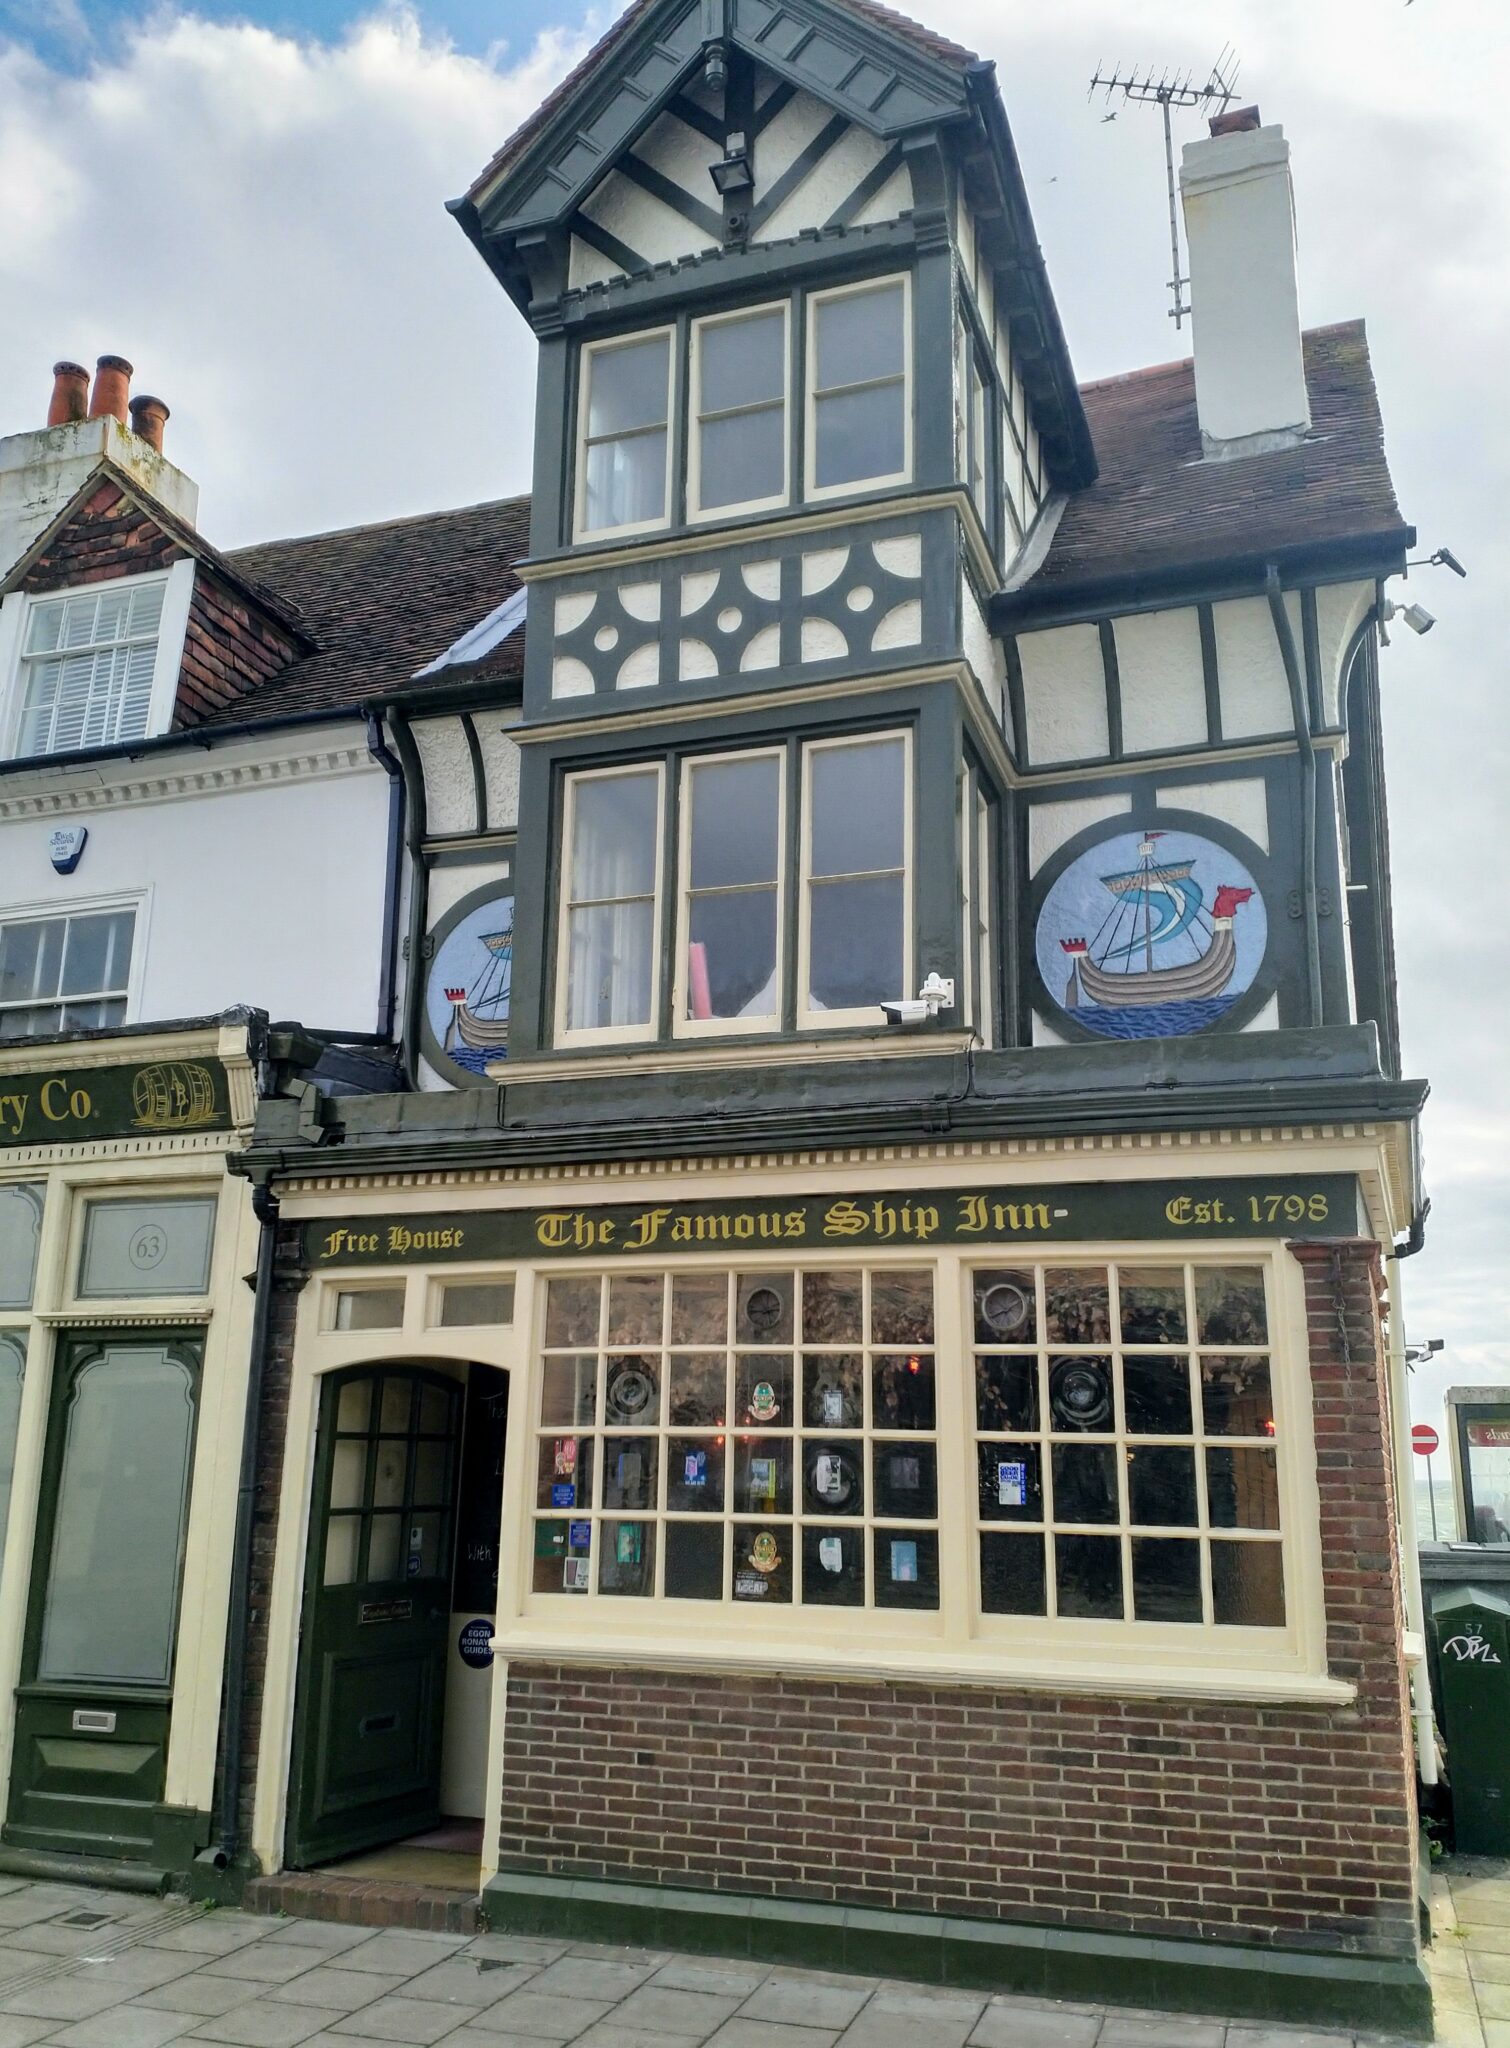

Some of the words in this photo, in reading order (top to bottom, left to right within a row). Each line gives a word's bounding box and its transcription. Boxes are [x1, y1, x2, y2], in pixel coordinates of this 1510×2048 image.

[40, 1079, 91, 1121] Co
[1165, 1197, 1236, 1225] Est.
[1249, 1194, 1330, 1222] 1798
[535, 1213, 615, 1248] The
[623, 1208, 807, 1249] Famous
[823, 1200, 940, 1239] Ship
[956, 1195, 1052, 1232] Inn
[136, 1236, 160, 1258] 63
[321, 1229, 379, 1258] Free
[388, 1226, 465, 1255] House
[467, 1543, 493, 1561] With
[468, 1629, 491, 1638] EGON
[1465, 1623, 1483, 1635] 57
[463, 1646, 495, 1654] GUIDES
